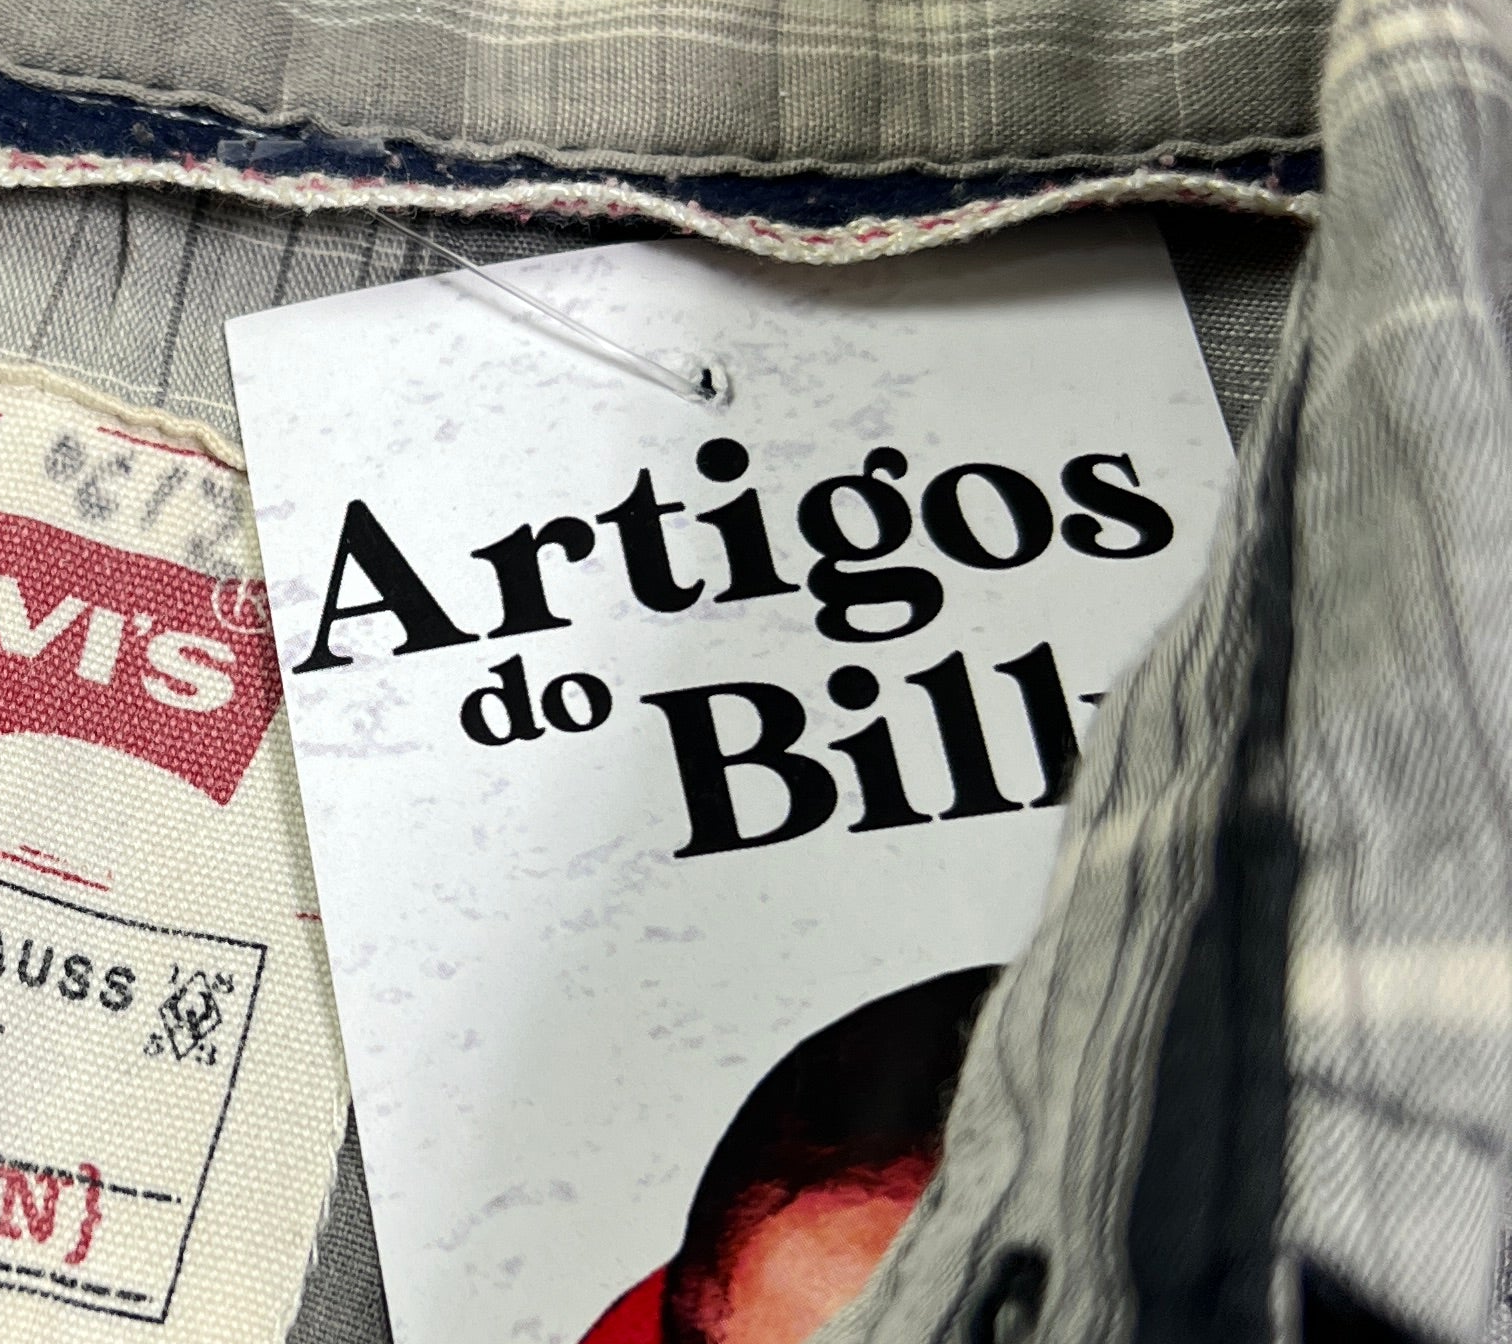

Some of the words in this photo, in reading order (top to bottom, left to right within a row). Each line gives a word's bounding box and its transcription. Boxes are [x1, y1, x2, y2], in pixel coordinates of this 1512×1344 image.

[291, 437, 1175, 675] Artigos
[460, 653, 613, 746] do
[639, 641, 1108, 859] Bill
